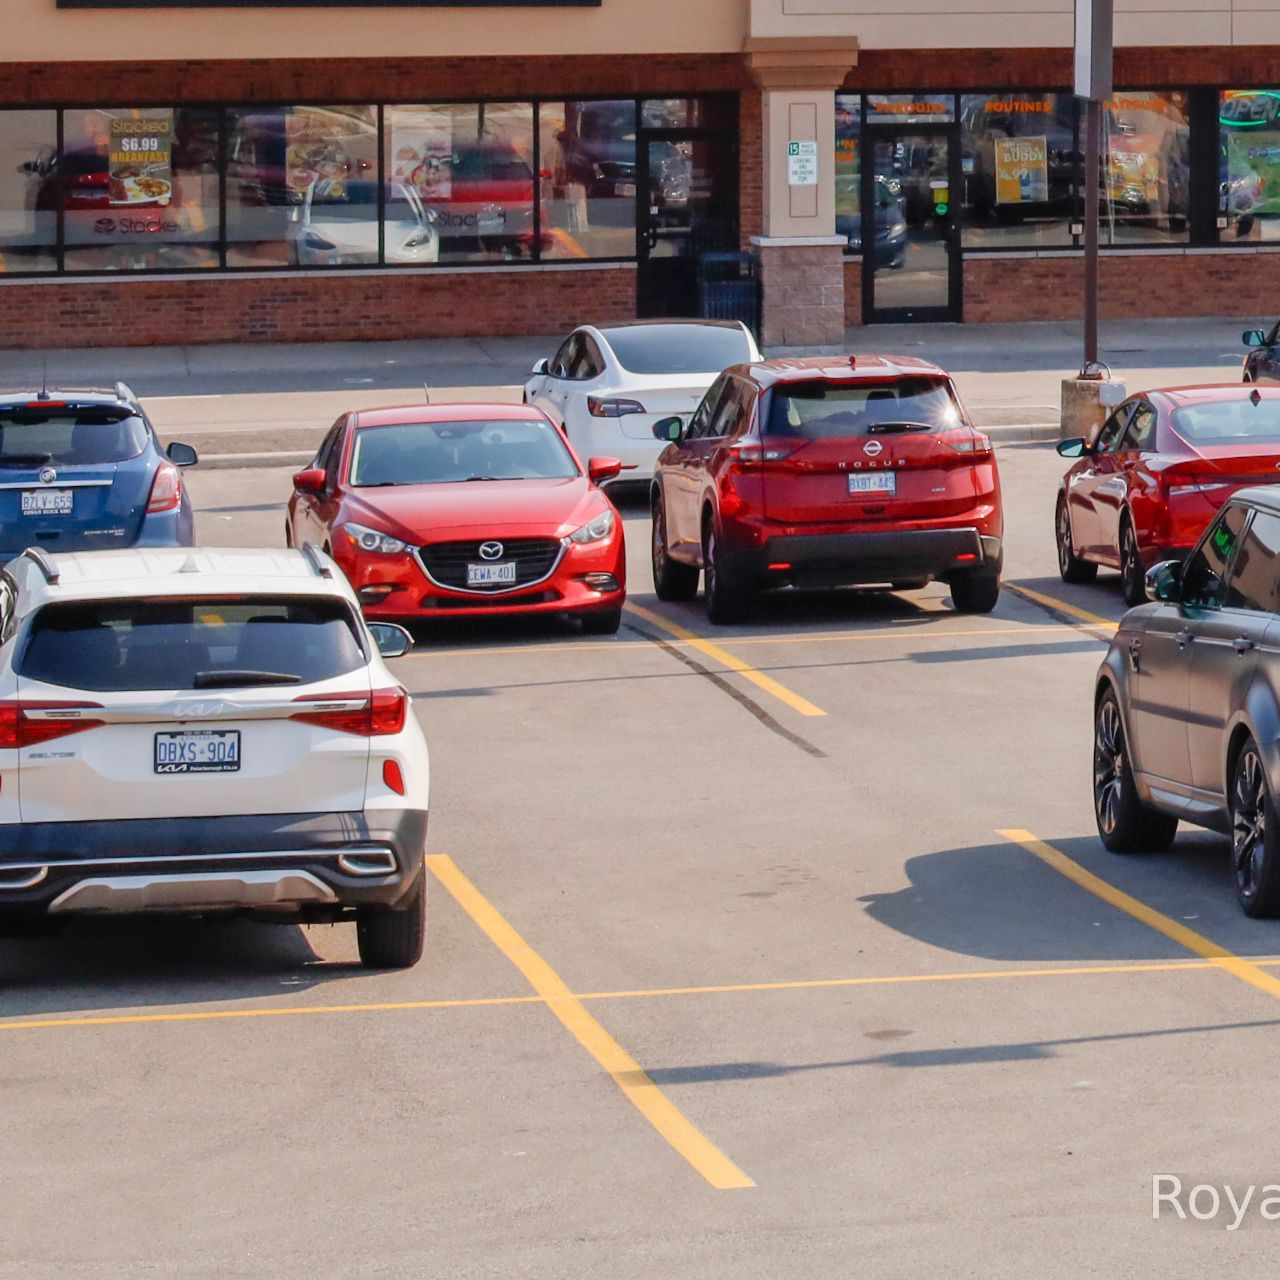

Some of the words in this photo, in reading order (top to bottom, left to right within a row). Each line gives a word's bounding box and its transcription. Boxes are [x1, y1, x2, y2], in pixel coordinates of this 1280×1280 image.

[1219, 99, 1280, 120] OPEN
[112, 120, 169, 134] Stacked
[121, 137, 159, 152] $6.99
[110, 151, 169, 165] BREAKFAST
[439, 210, 507, 228] Stacd
[838, 459, 906, 468] ROGUE
